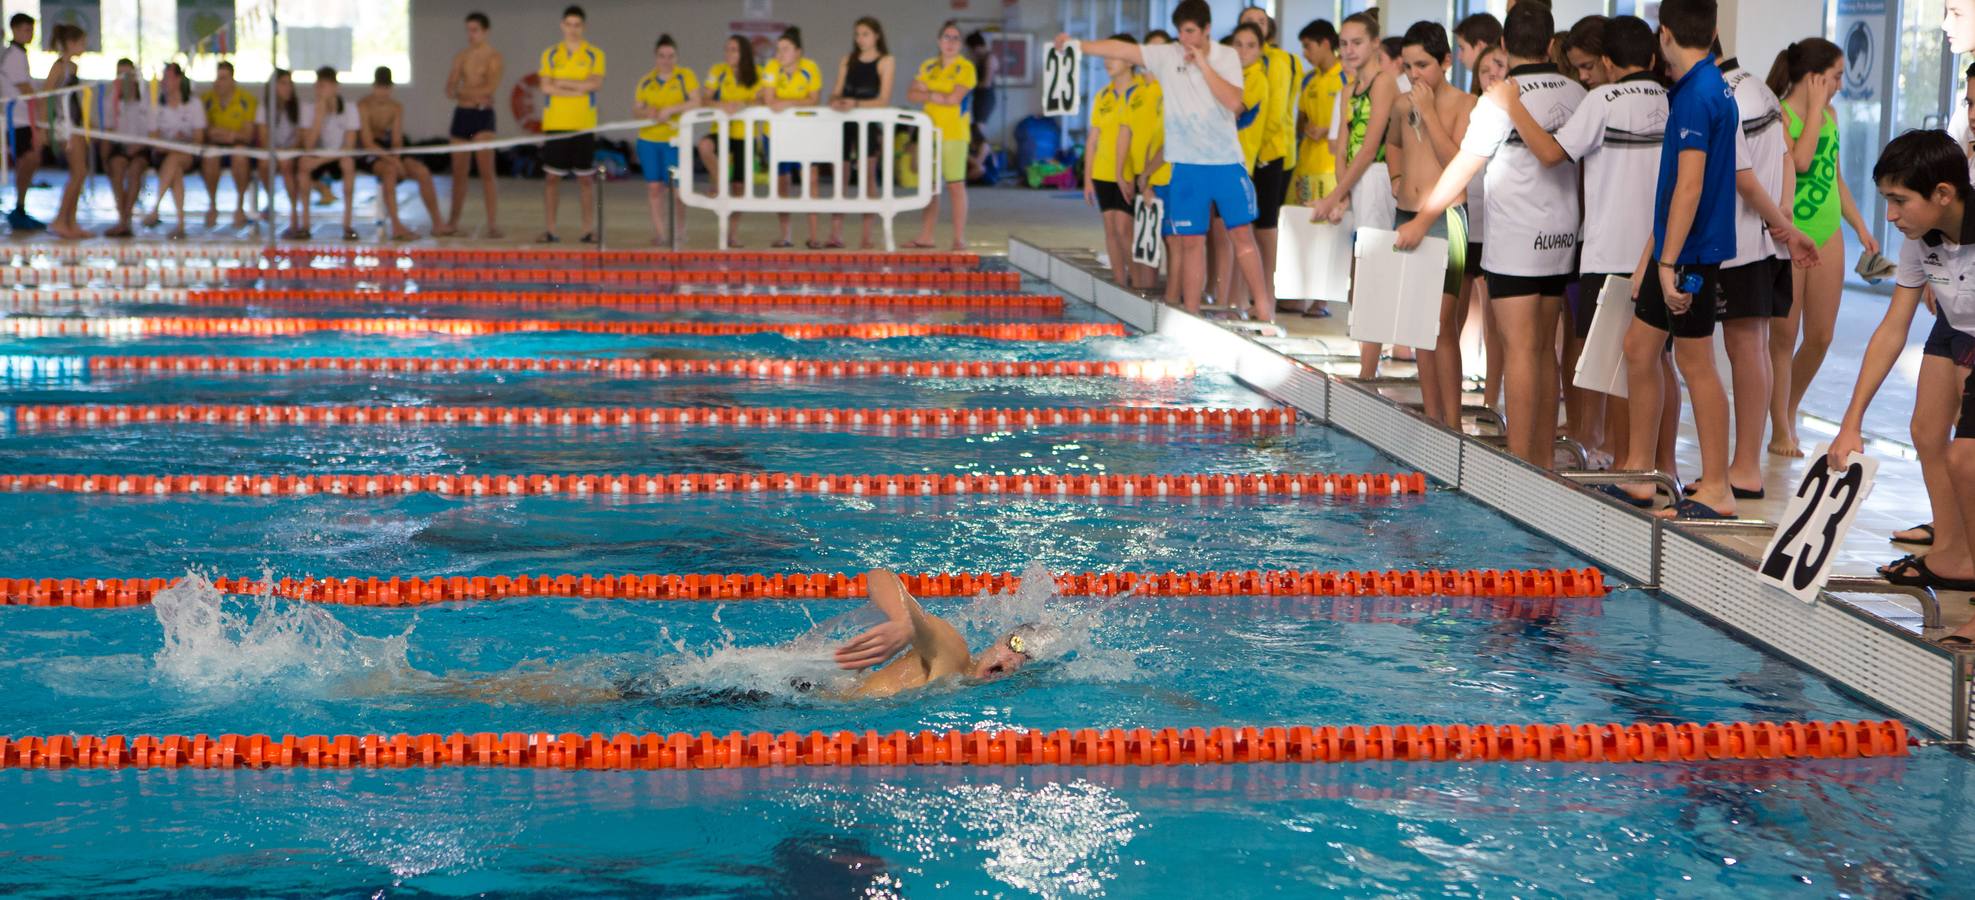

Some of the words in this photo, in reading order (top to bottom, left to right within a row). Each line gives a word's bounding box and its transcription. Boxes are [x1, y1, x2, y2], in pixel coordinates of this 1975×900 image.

[1046, 46, 1075, 112] 23
[1135, 201, 1158, 263] 23
[1534, 230, 1574, 250] ÁLVARO
[1761, 453, 1863, 591] 23
